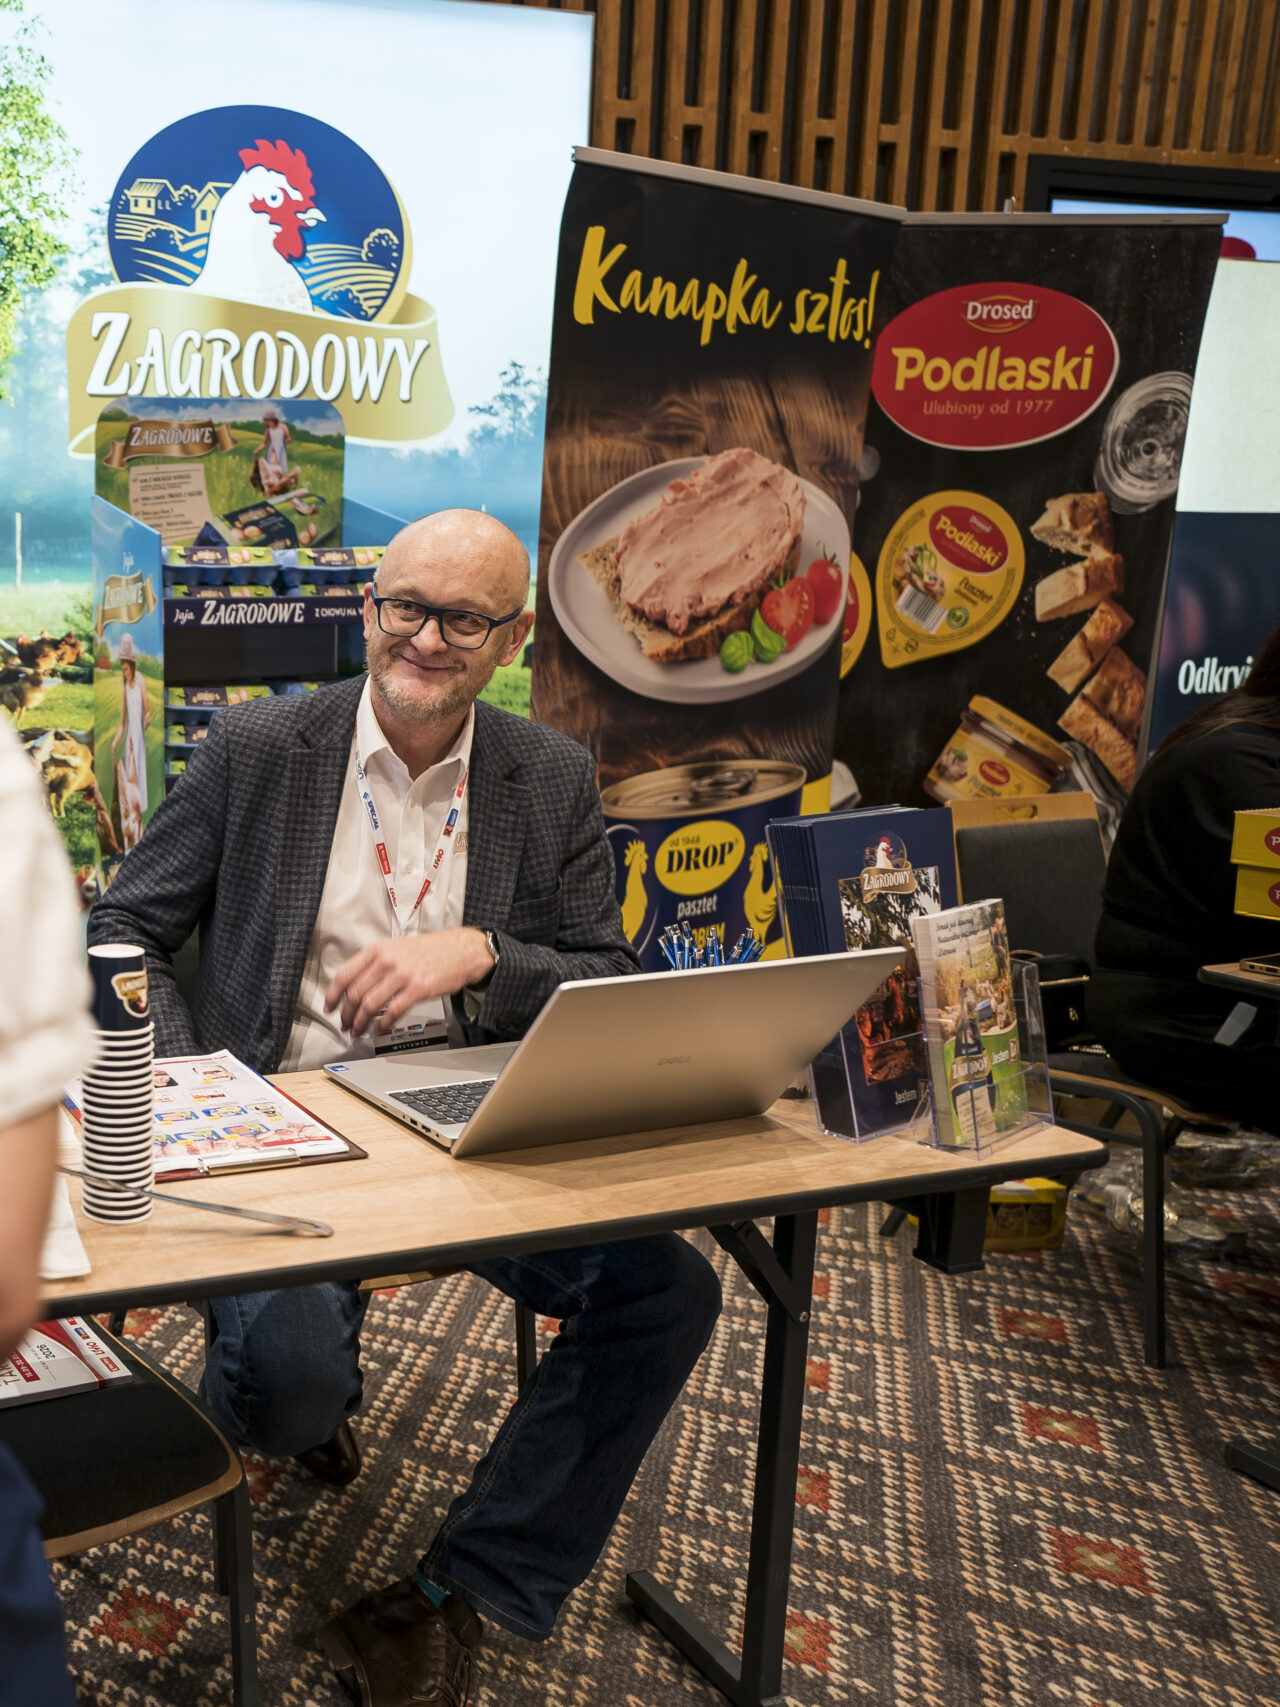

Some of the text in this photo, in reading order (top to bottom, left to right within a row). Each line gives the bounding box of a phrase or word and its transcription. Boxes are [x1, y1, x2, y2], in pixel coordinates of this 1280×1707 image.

[573, 225, 880, 350] Kanapka sztos!
[966, 299, 1034, 321] Drosed
[85, 311, 431, 404] ZAGRODOWY
[891, 344, 1095, 393] Podlaski
[922, 400, 1054, 420] Ulubiony od 1977
[129, 426, 214, 447] ZAGRODOWE
[935, 514, 1003, 567] Podlaski
[173, 608, 195, 625] Jaja
[200, 600, 306, 626] ZAGRODOWE
[314, 608, 320, 618] Z
[321, 607, 347, 618] CHOWU
[347, 608, 357, 617] NA
[681, 835, 701, 846] 1948
[666, 841, 735, 874] DROP
[863, 870, 911, 891] ZAGRODOWY
[676, 893, 718, 921] pasztet
[894, 1088, 918, 1106] Jestem
